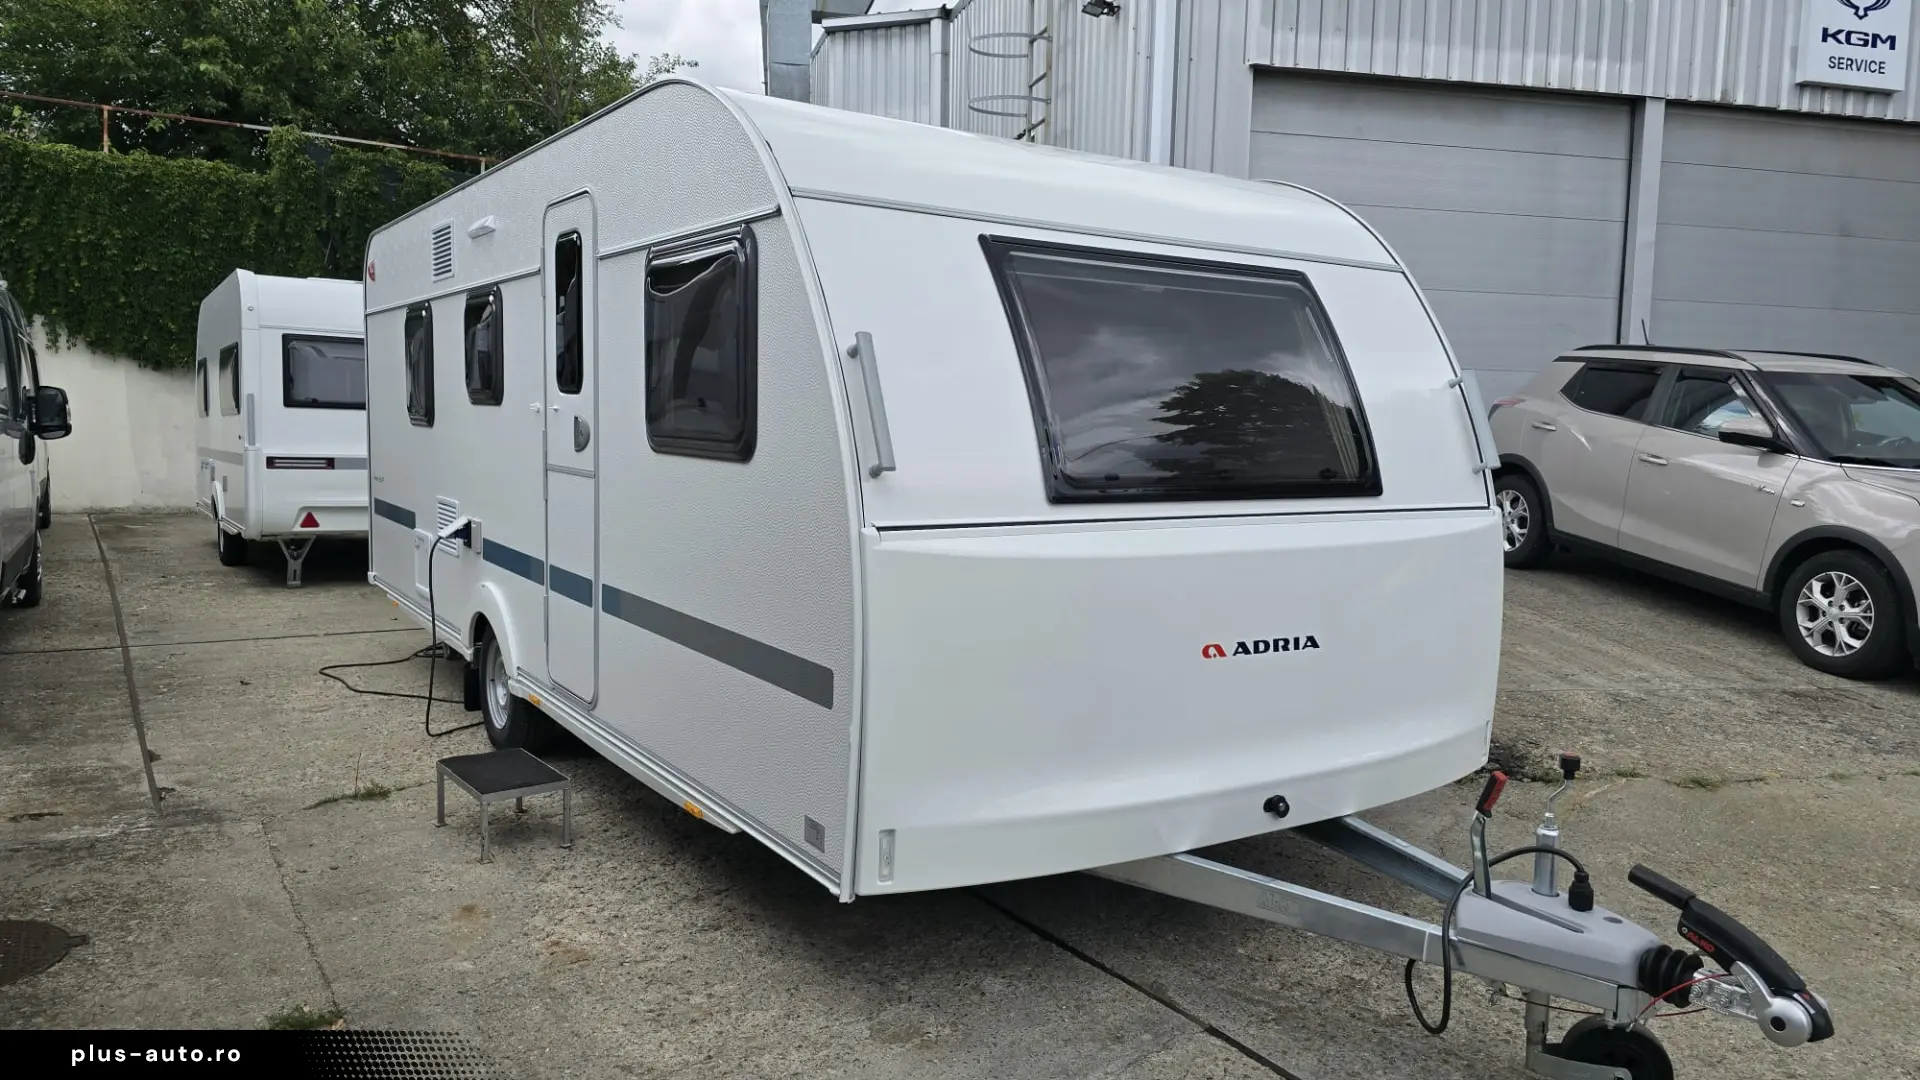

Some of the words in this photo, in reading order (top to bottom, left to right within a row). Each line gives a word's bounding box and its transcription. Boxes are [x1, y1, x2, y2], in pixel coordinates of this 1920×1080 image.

[1821, 26, 1897, 51] KGM
[1828, 55, 1886, 75] SERVICE
[1232, 635, 1321, 657] ADRIA
